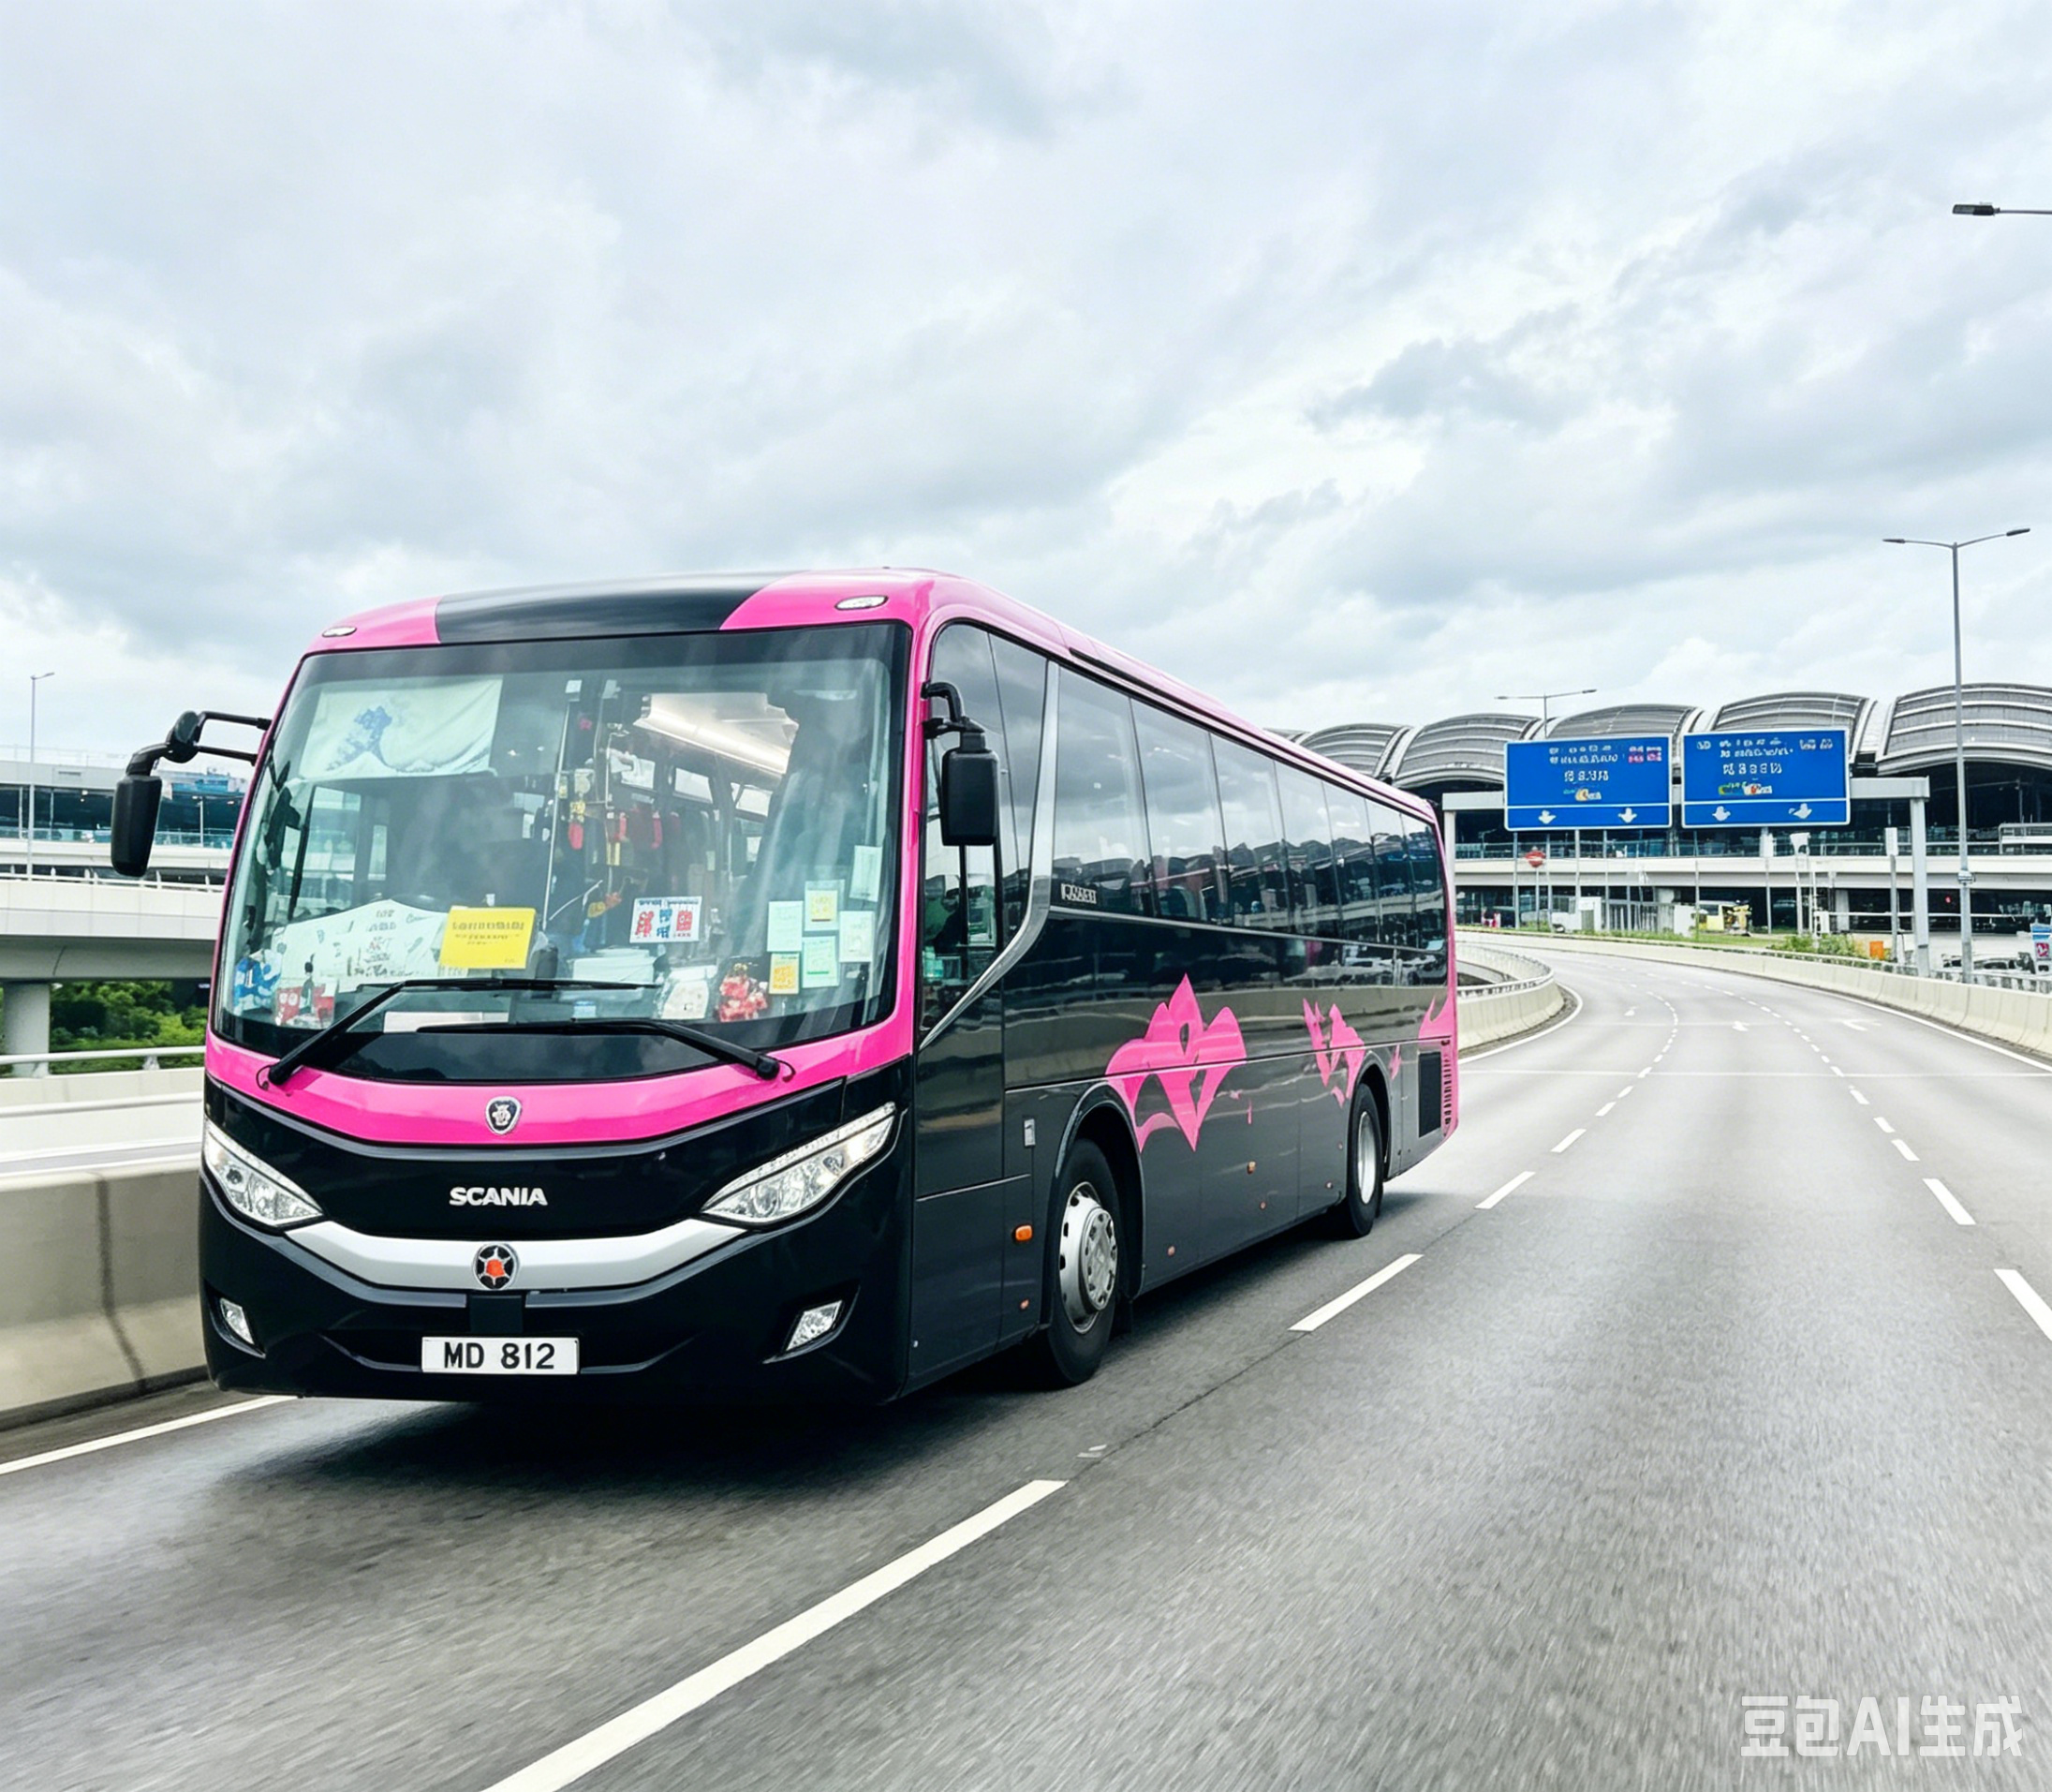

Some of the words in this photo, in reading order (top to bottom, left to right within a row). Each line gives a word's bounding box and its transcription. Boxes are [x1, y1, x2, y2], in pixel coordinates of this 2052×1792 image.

[449, 1187, 549, 1207] SCANIA
[443, 1341, 485, 1370] MD
[500, 1342, 555, 1370] 812
